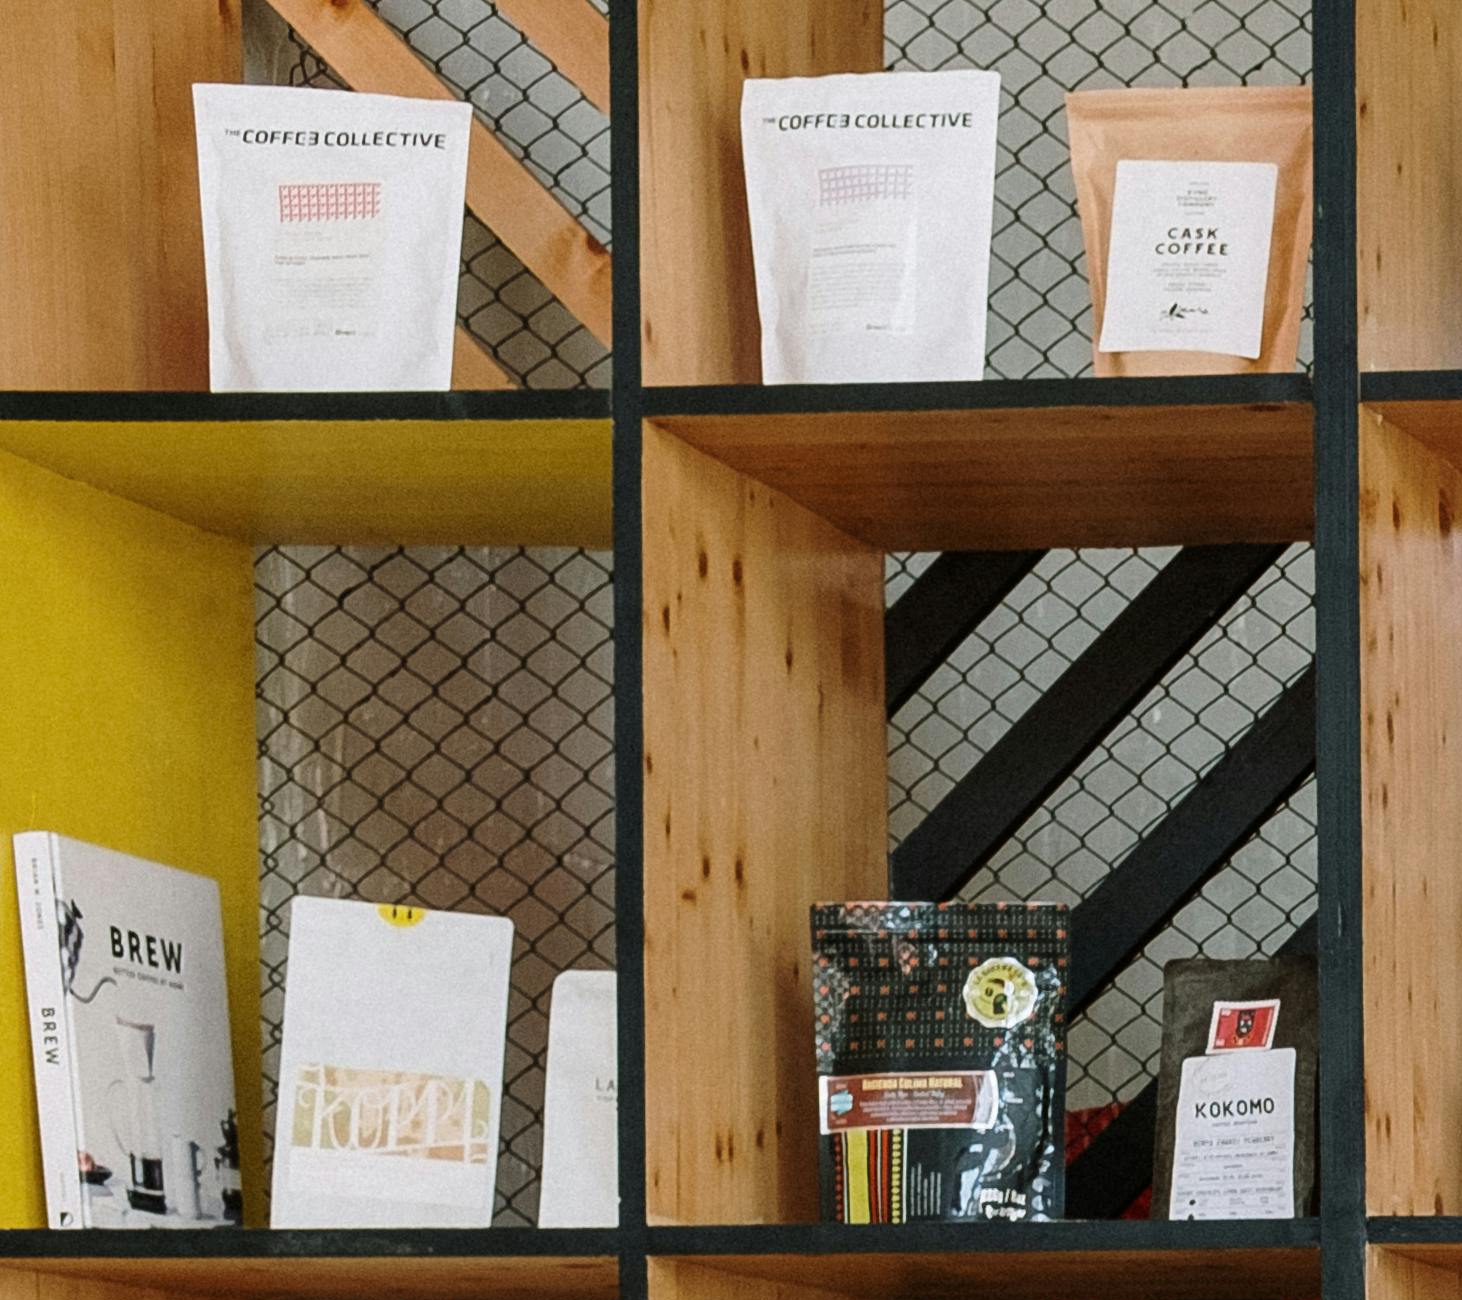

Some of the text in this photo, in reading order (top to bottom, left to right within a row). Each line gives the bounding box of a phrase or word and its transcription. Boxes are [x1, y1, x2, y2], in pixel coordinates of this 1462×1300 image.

[855, 113, 973, 128] COLLECTIVE
[324, 131, 447, 148] COLLECTIVE
[1167, 227, 1219, 240] CASK
[1155, 242, 1229, 255] COFFEE
[110, 926, 181, 974] BREW
[41, 1007, 60, 1066] BREW
[1195, 1098, 1275, 1119] KOKOMO
